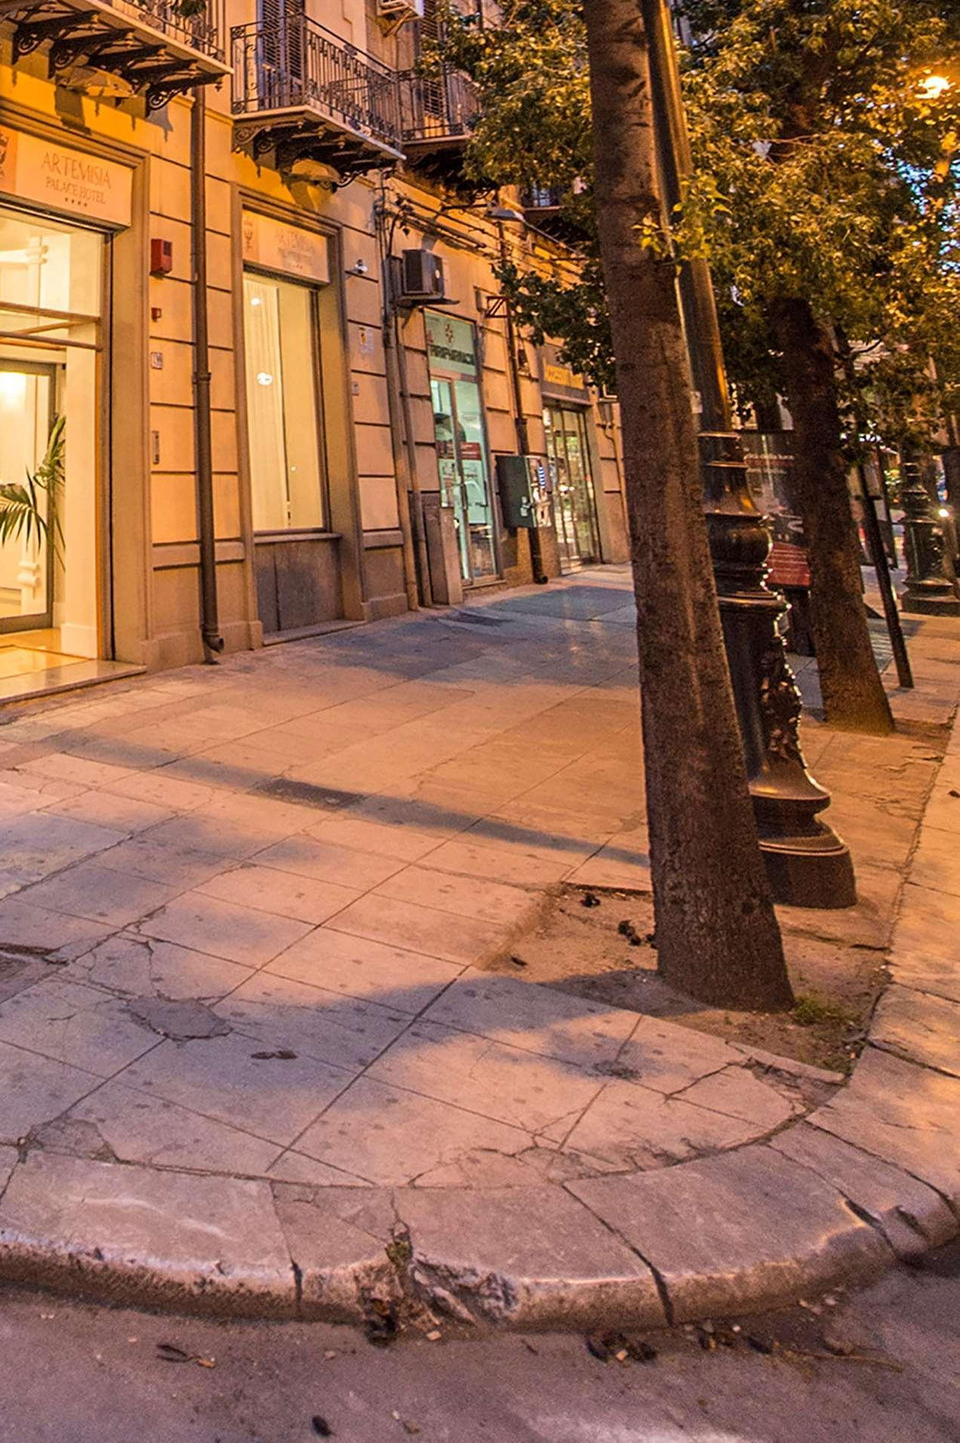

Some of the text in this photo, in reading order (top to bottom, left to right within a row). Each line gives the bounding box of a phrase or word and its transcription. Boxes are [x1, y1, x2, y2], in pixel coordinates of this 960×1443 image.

[41, 151, 112, 190] ARTEMISIA
[45, 176, 107, 204] PALACE HOTEL
